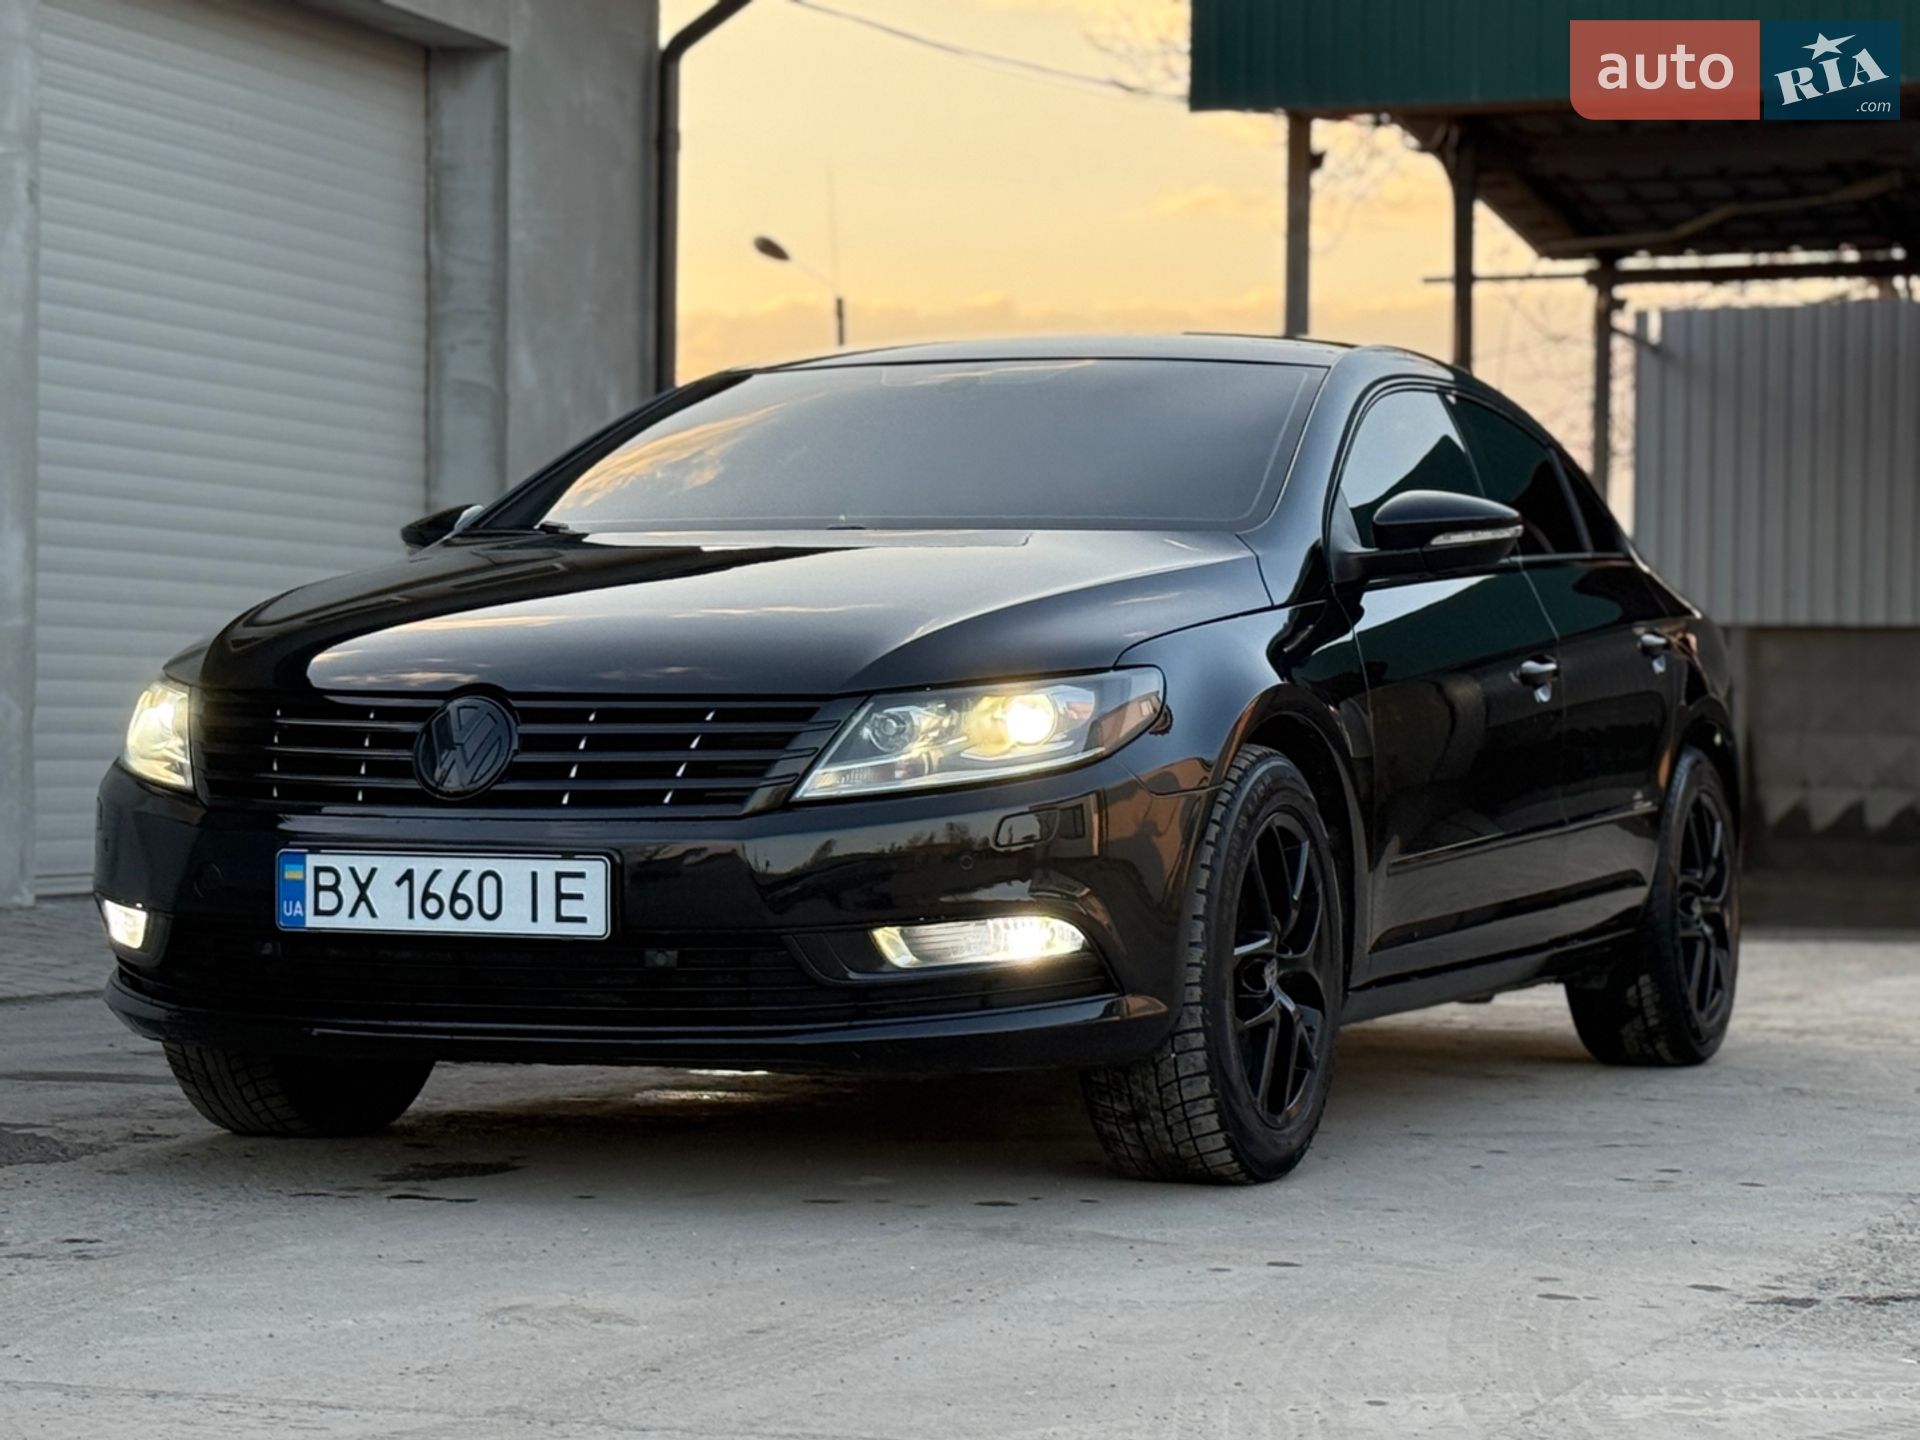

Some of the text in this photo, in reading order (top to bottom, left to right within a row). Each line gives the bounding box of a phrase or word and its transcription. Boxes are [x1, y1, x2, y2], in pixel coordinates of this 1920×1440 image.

[283, 901, 304, 917] UA
[313, 866, 588, 924] BX 1660 IE
